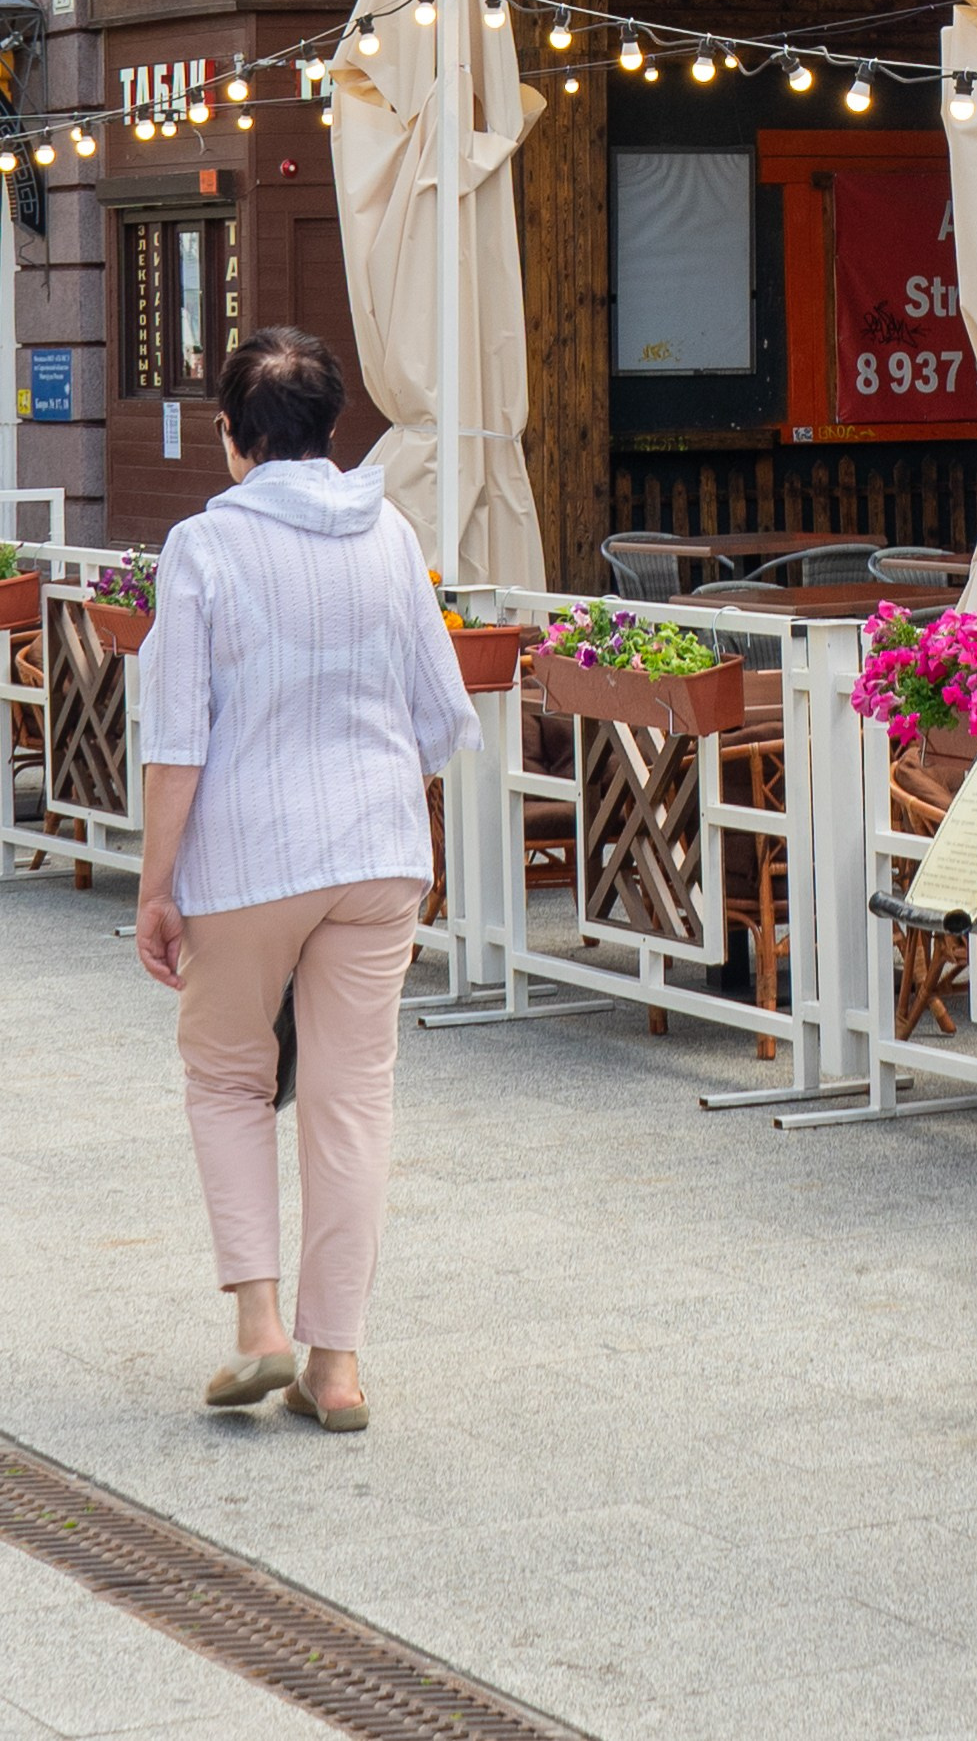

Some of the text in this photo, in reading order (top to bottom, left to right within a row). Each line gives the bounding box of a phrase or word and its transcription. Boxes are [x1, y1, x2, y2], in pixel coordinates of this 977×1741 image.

[295, 59, 334, 101] ТА
[137, 225, 149, 387] ЭЛЕКТРОННЫЕ
[225, 220, 240, 354] ТАБА
[904, 274, 960, 319] Str
[855, 351, 880, 395] 8
[887, 350, 963, 395] 937
